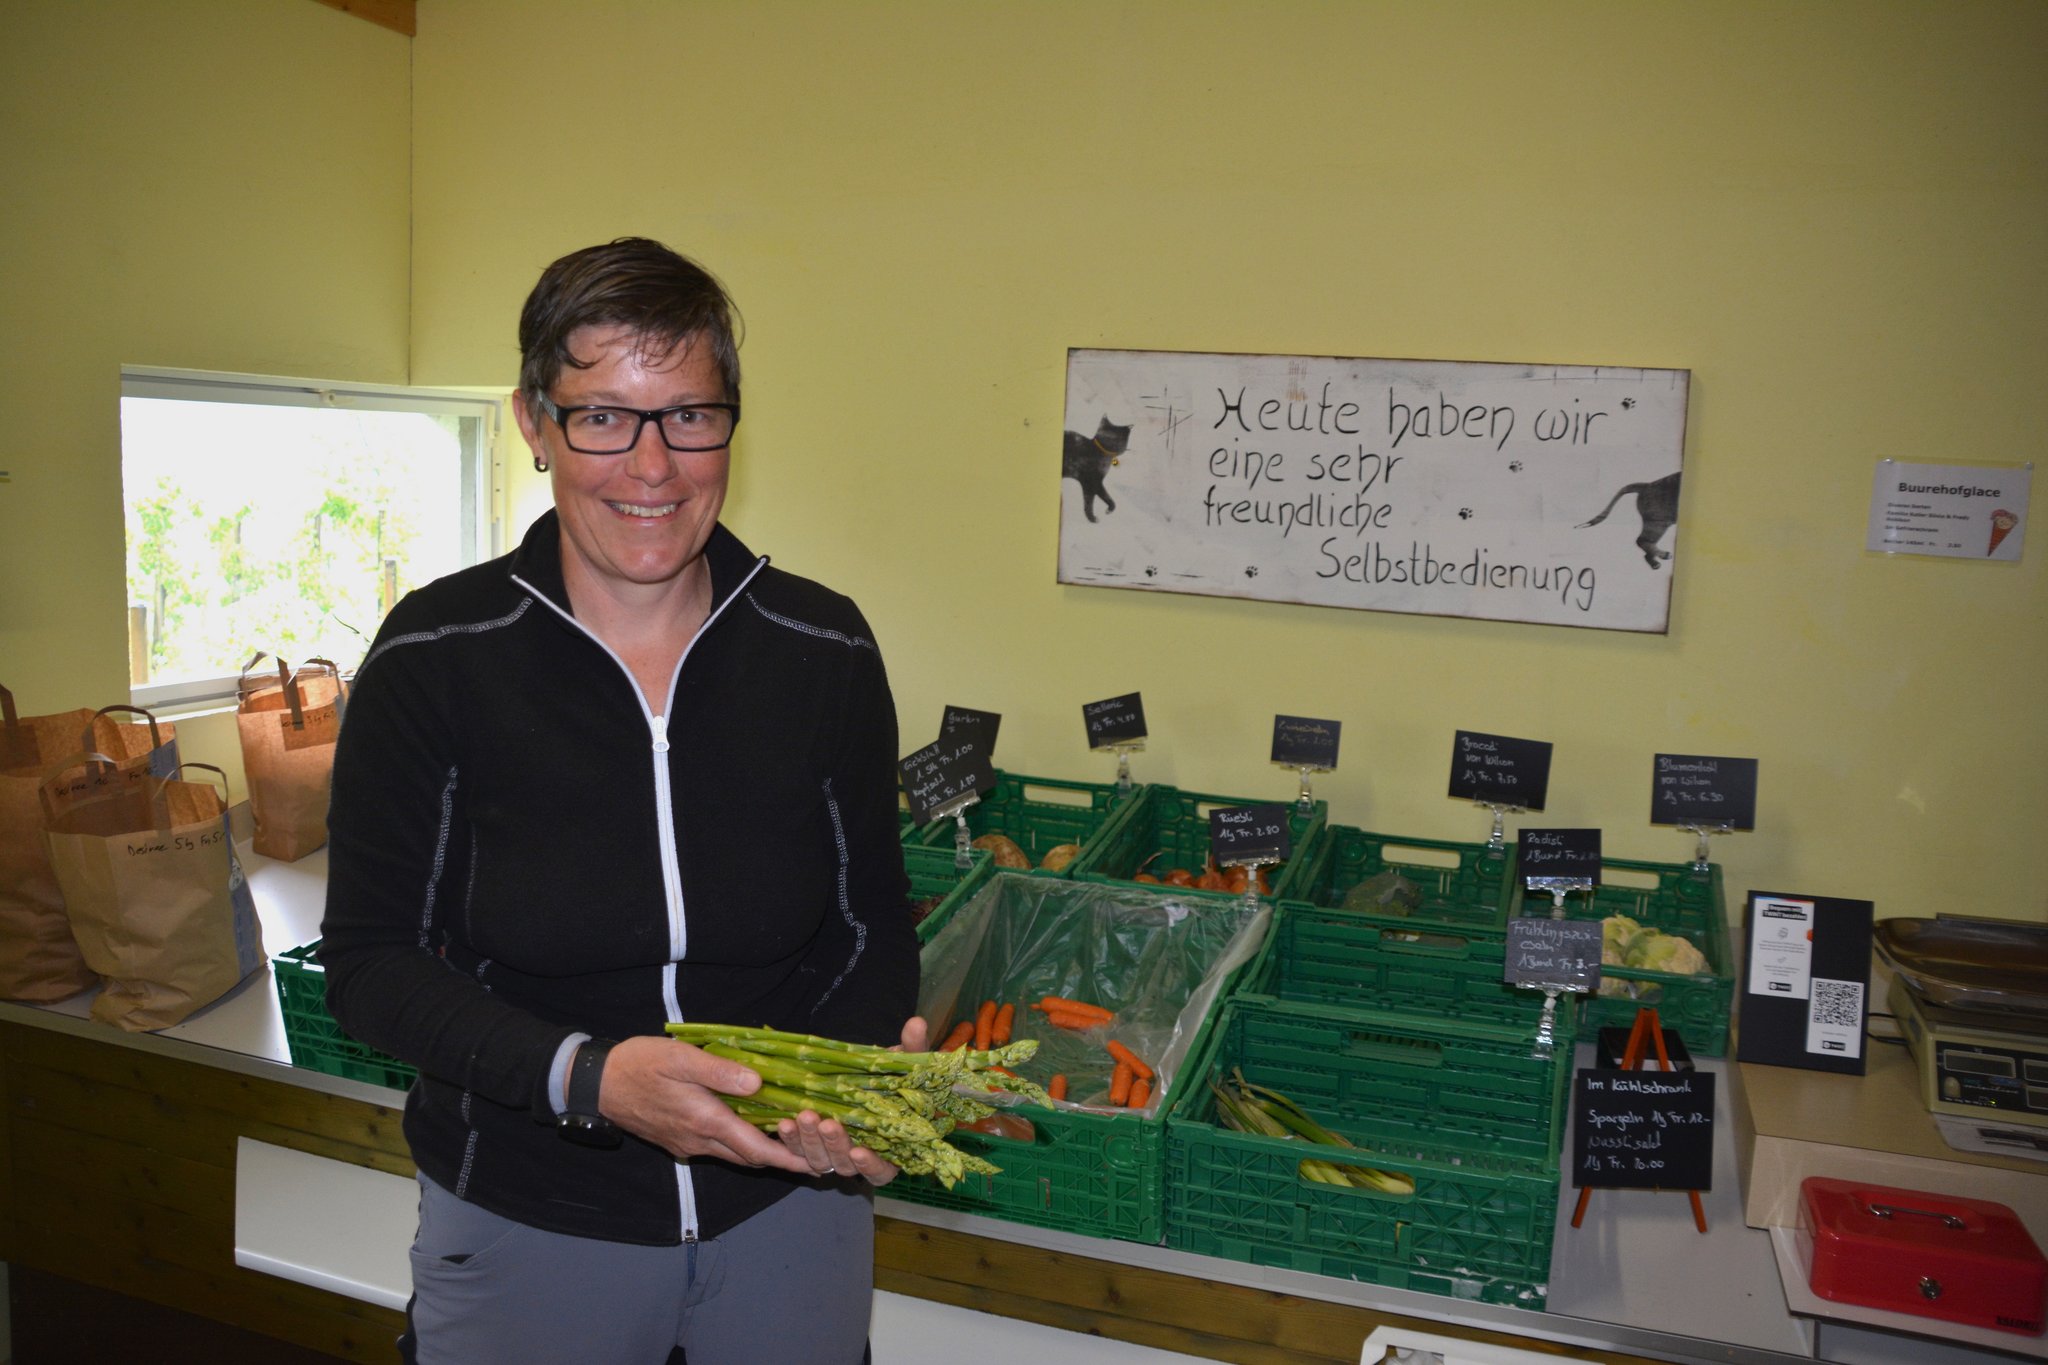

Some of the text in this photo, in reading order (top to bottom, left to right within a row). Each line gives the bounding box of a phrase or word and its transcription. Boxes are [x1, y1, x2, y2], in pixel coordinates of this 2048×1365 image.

[1214, 382, 1609, 450] Heute haben wir
[1208, 438, 1404, 495] eine sehr
[1898, 483, 2001, 498] Buurehofglace
[1203, 486, 1393, 538] freundliche
[1315, 537, 1596, 611] Selbstbedienung
[1236, 828, 1253, 837] Fr.
[1587, 1078, 1604, 1090] Im
[1588, 1109, 1645, 1132] Spargeln
[1667, 1111, 1686, 1124] Fr.
[1607, 1156, 1625, 1169] Fr.
